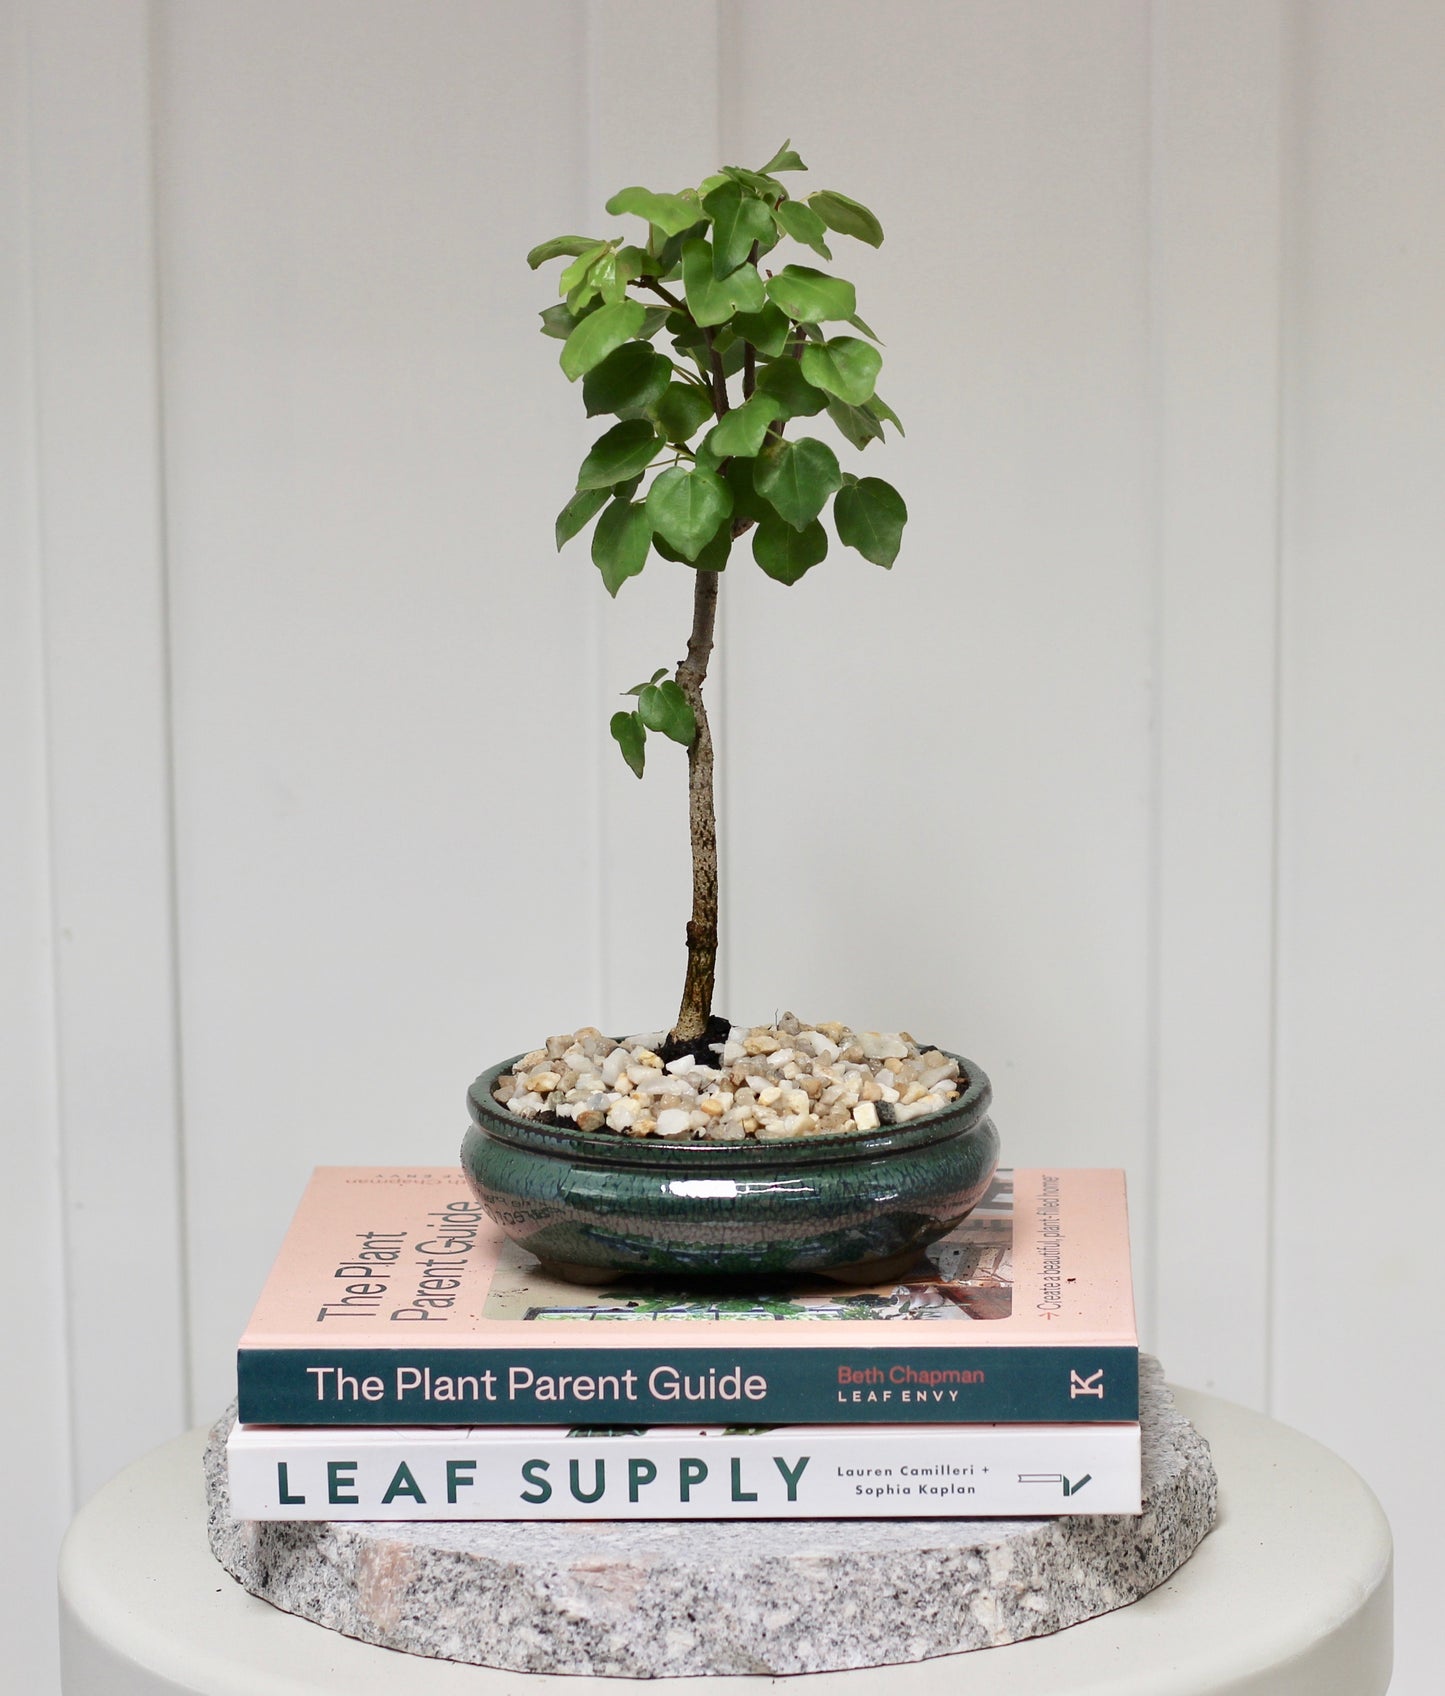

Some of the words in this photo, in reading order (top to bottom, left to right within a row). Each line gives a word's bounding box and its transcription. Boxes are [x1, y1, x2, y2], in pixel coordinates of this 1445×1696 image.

[414, 1201, 482, 1255] Guide
[334, 1231, 408, 1278] Plant
[1036, 1239, 1064, 1275] beautiful,
[316, 1283, 388, 1322] The
[390, 1259, 469, 1321] Parent
[1036, 1283, 1062, 1310] Create
[306, 1366, 385, 1401] The
[396, 1366, 498, 1401] Plant
[508, 1366, 639, 1401] Parent
[648, 1366, 768, 1401] Guide
[838, 1366, 884, 1385] Beth
[889, 1366, 985, 1387] Chapman
[1070, 1369, 1104, 1400] K
[838, 1390, 893, 1403] LEAF
[901, 1390, 959, 1403] ENVY
[277, 1458, 478, 1505] LEAF
[519, 1456, 811, 1504] SUPPLY
[838, 1465, 893, 1477] Lauren
[899, 1464, 974, 1477] Camilleri
[855, 1483, 911, 1499] Sophia
[918, 1483, 976, 1498] Kaplan
